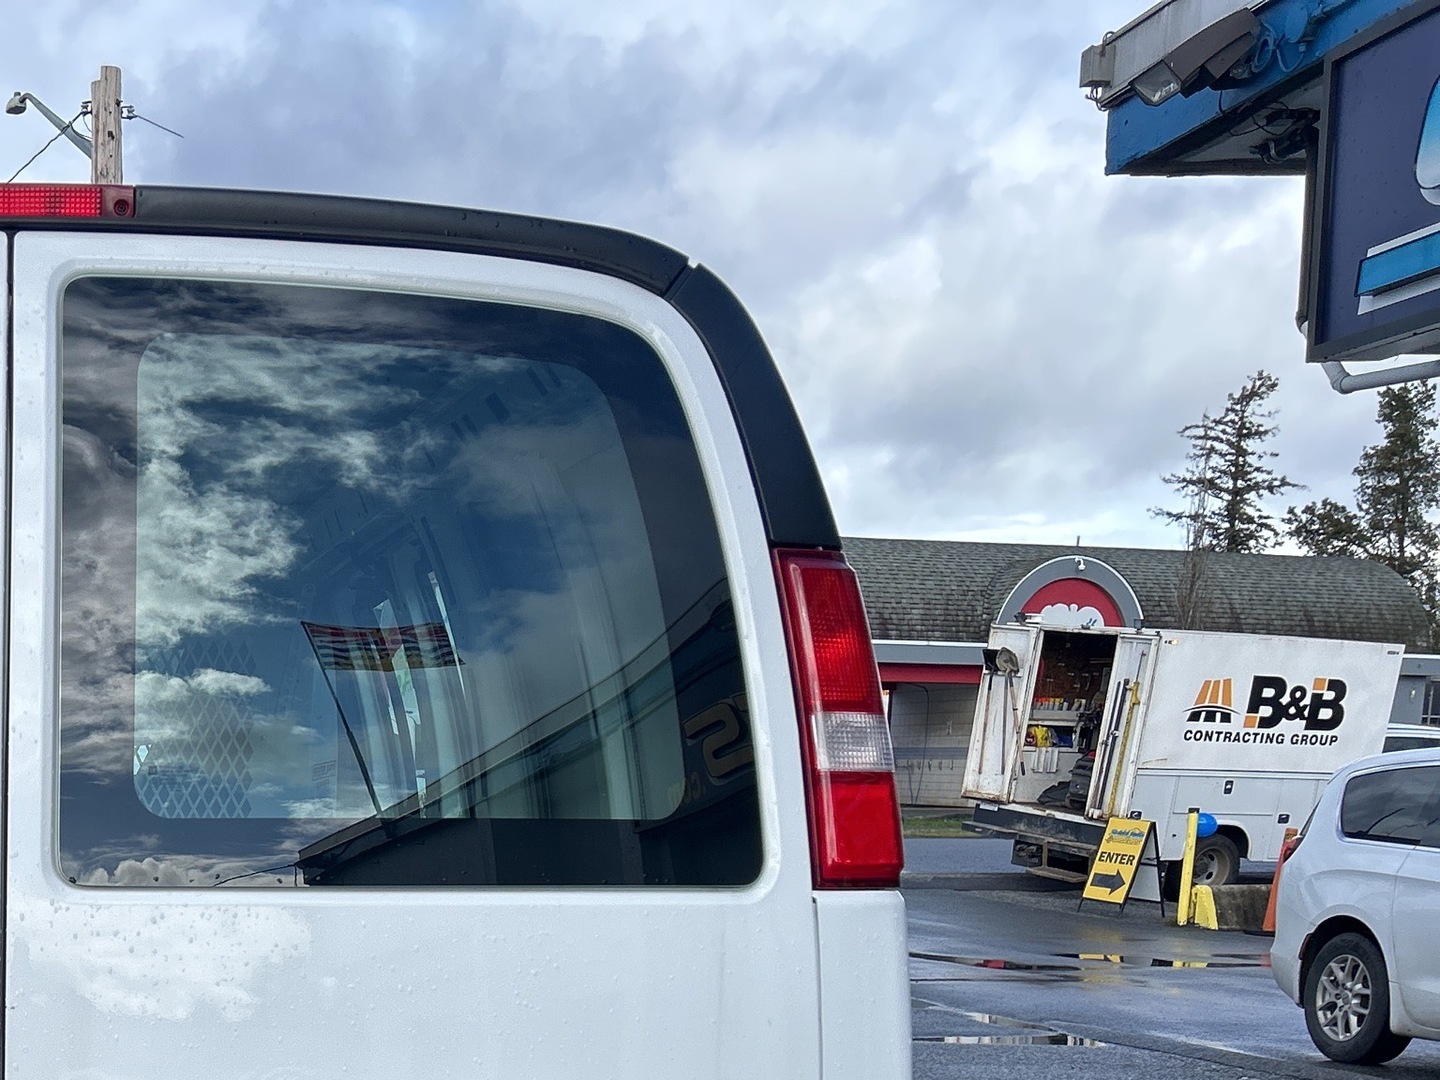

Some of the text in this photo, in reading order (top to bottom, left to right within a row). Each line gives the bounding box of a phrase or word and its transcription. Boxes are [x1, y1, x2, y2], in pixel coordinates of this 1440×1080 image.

[1243, 675, 1348, 731] B&B
[1183, 729, 1339, 746] CONTRACTING GROUP
[1098, 851, 1136, 866] ENTER
